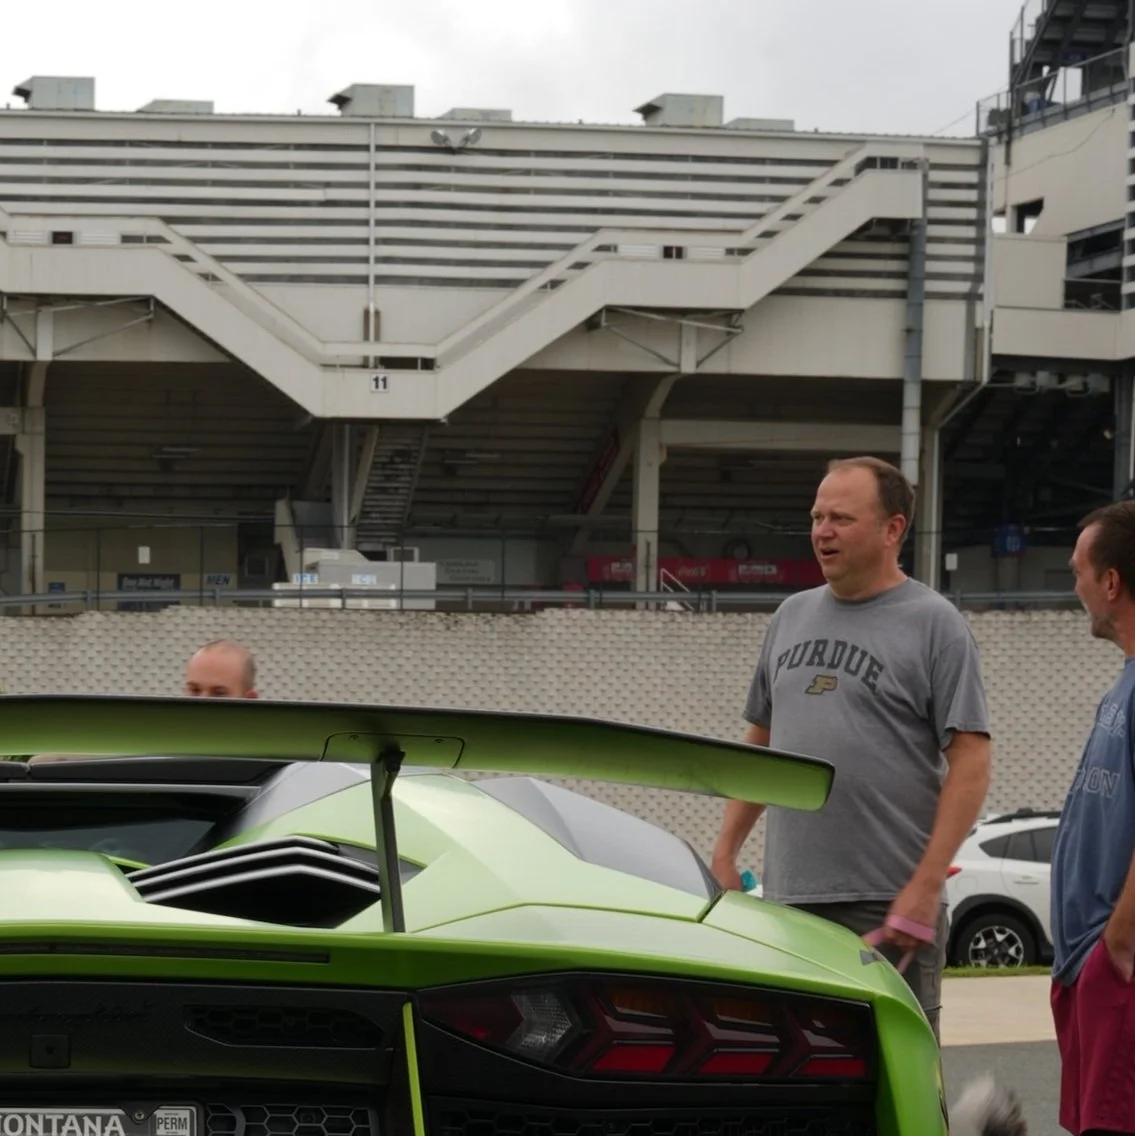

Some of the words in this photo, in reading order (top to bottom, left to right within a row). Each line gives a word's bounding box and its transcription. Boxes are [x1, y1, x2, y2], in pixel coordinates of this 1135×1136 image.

[373, 375, 388, 390] 11
[773, 638, 885, 697] PURDUE
[157, 1116, 188, 1131] PERM
